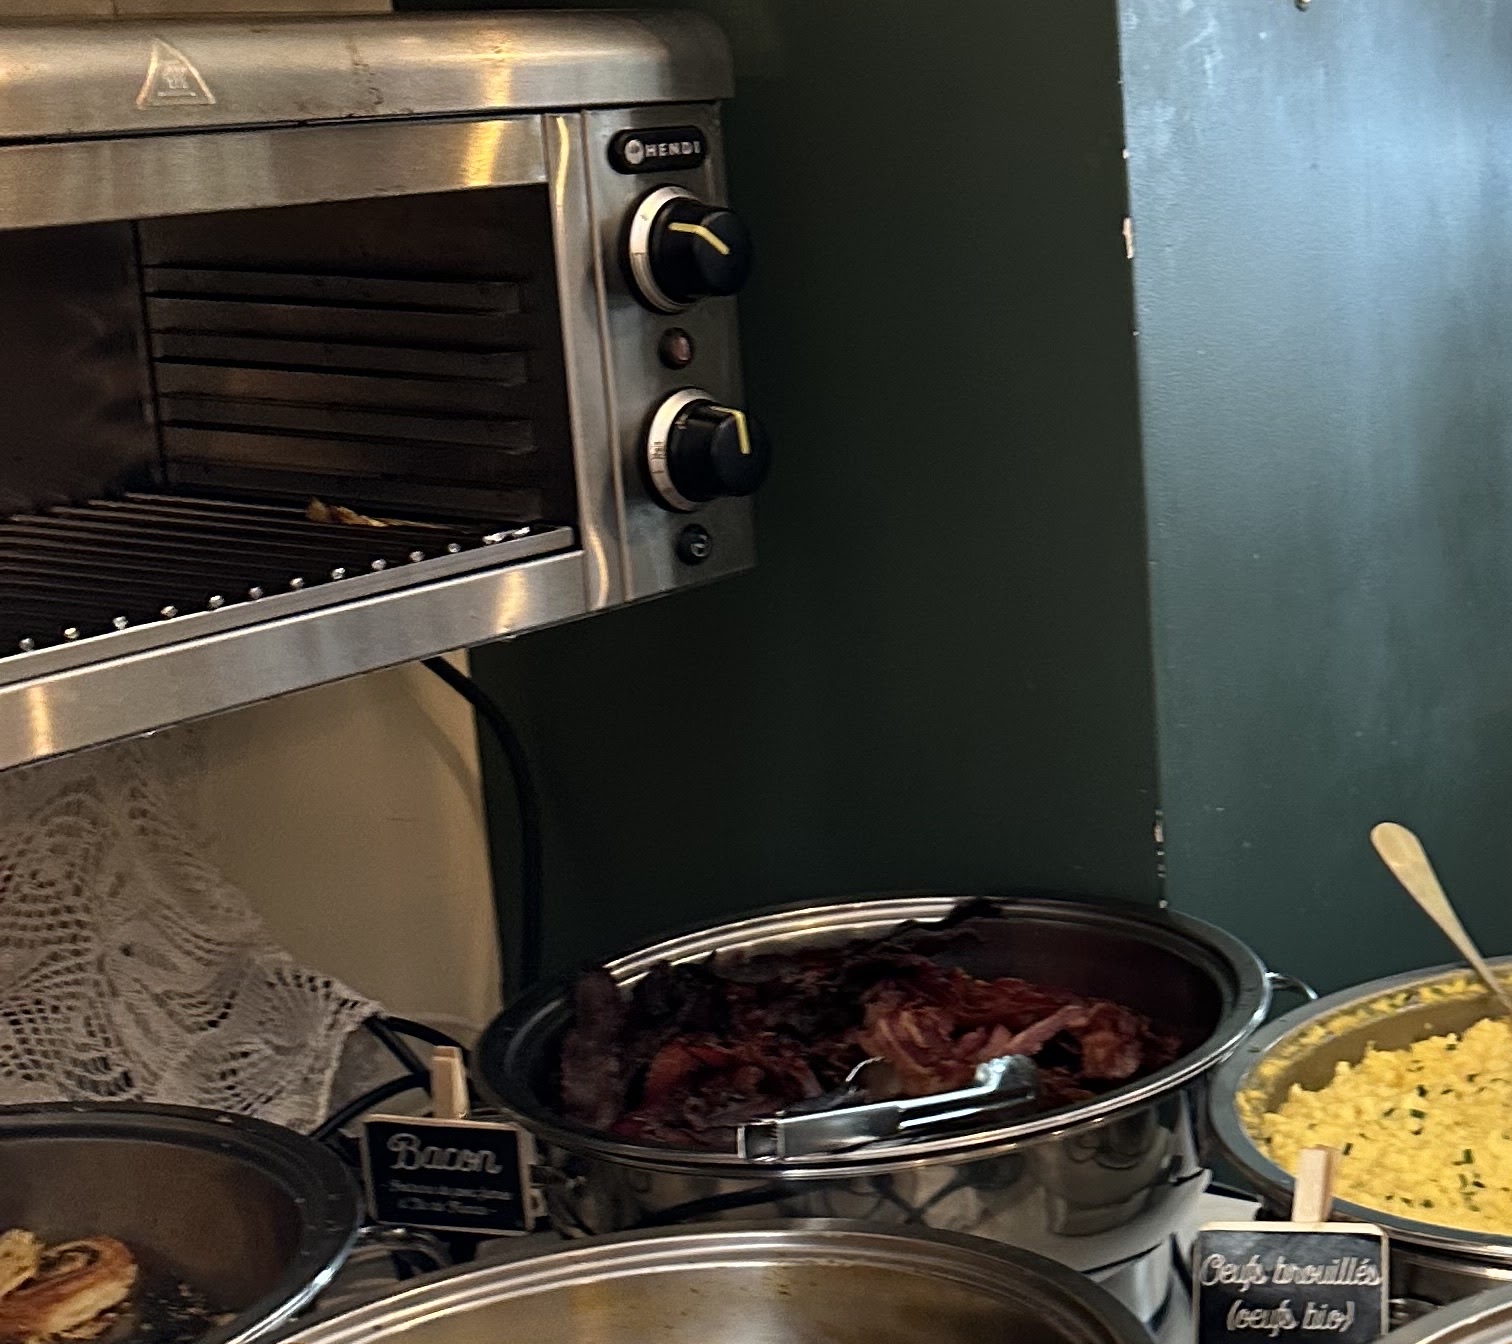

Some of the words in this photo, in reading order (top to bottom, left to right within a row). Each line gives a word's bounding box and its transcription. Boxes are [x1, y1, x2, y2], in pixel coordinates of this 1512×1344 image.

[645, 141, 701, 158] HENDI
[386, 1132, 503, 1174] Bacon
[1272, 1255, 1383, 1286] brouillés
[1302, 1300, 1356, 1333] bio)
